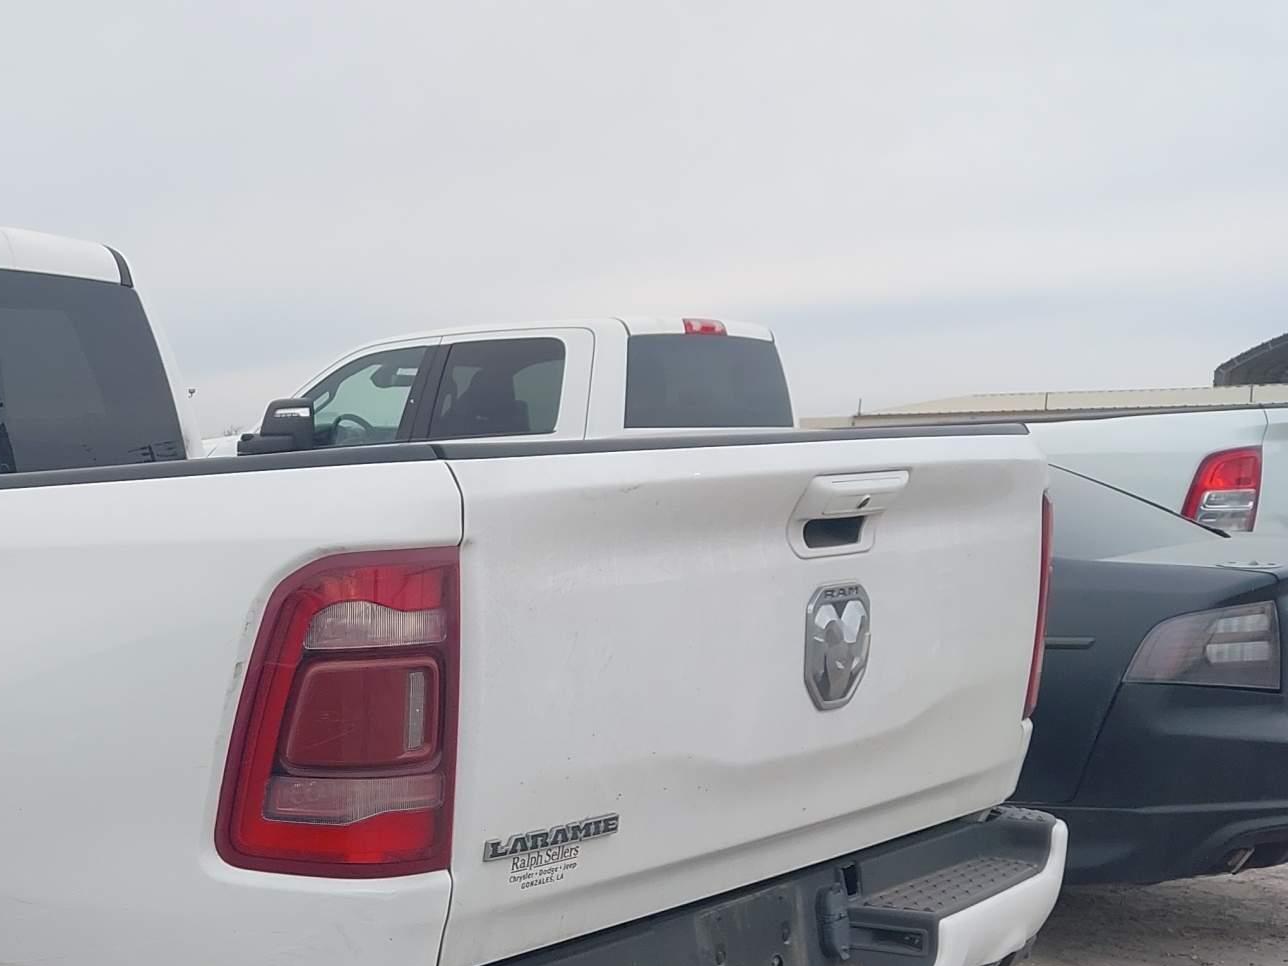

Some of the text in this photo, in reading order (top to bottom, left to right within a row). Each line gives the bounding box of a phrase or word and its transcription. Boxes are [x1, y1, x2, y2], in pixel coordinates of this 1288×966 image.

[824, 586, 859, 598] RAM
[483, 813, 619, 862] LARAMIE
[511, 845, 579, 873] Ralph Sellers
[509, 862, 577, 883] Chrysler Dodge Jeep
[521, 873, 564, 889] GONZALES, LA
